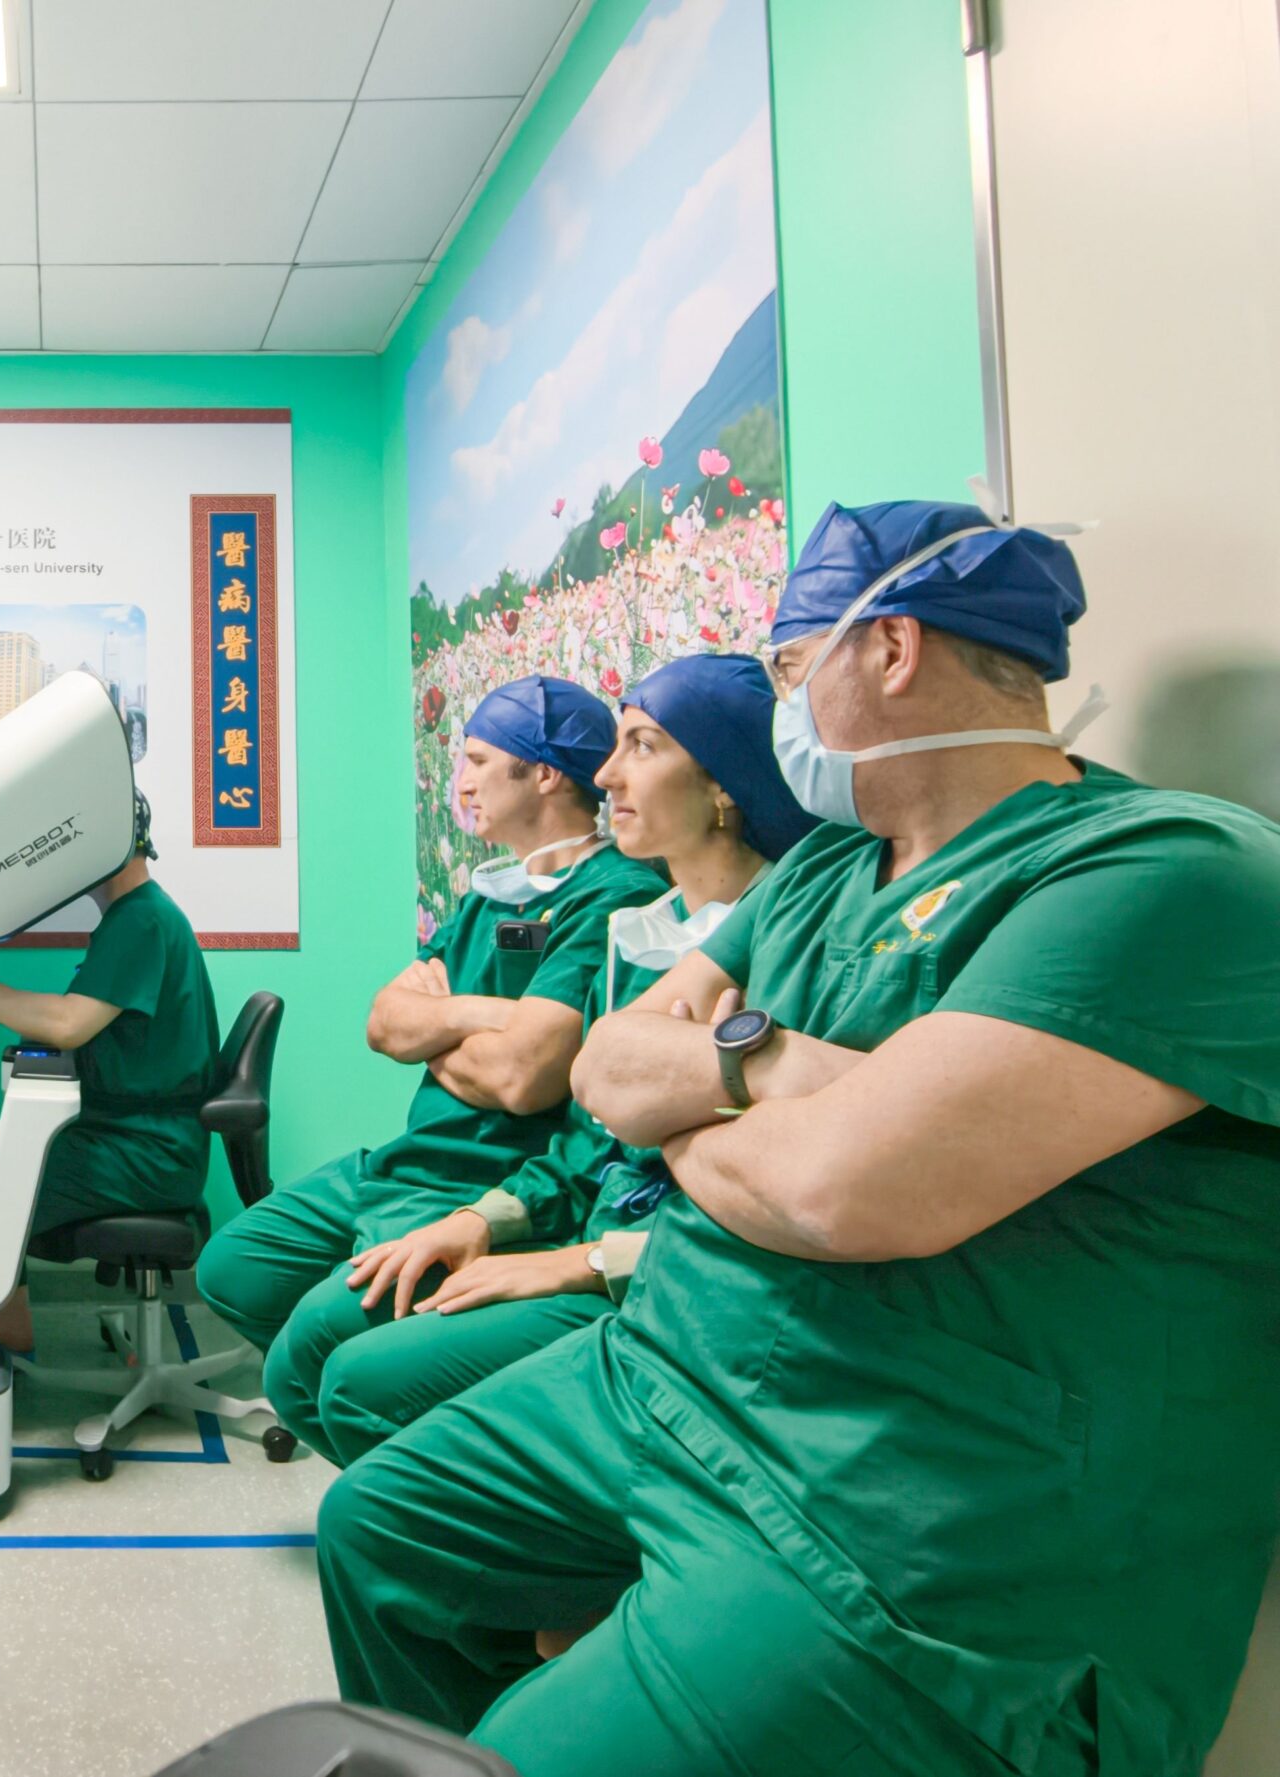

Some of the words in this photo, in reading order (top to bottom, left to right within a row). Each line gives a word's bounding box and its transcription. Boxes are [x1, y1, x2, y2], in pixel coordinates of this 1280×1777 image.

[33, 562, 104, 577] University
[215, 531, 254, 809] 醫病醫身醫心
